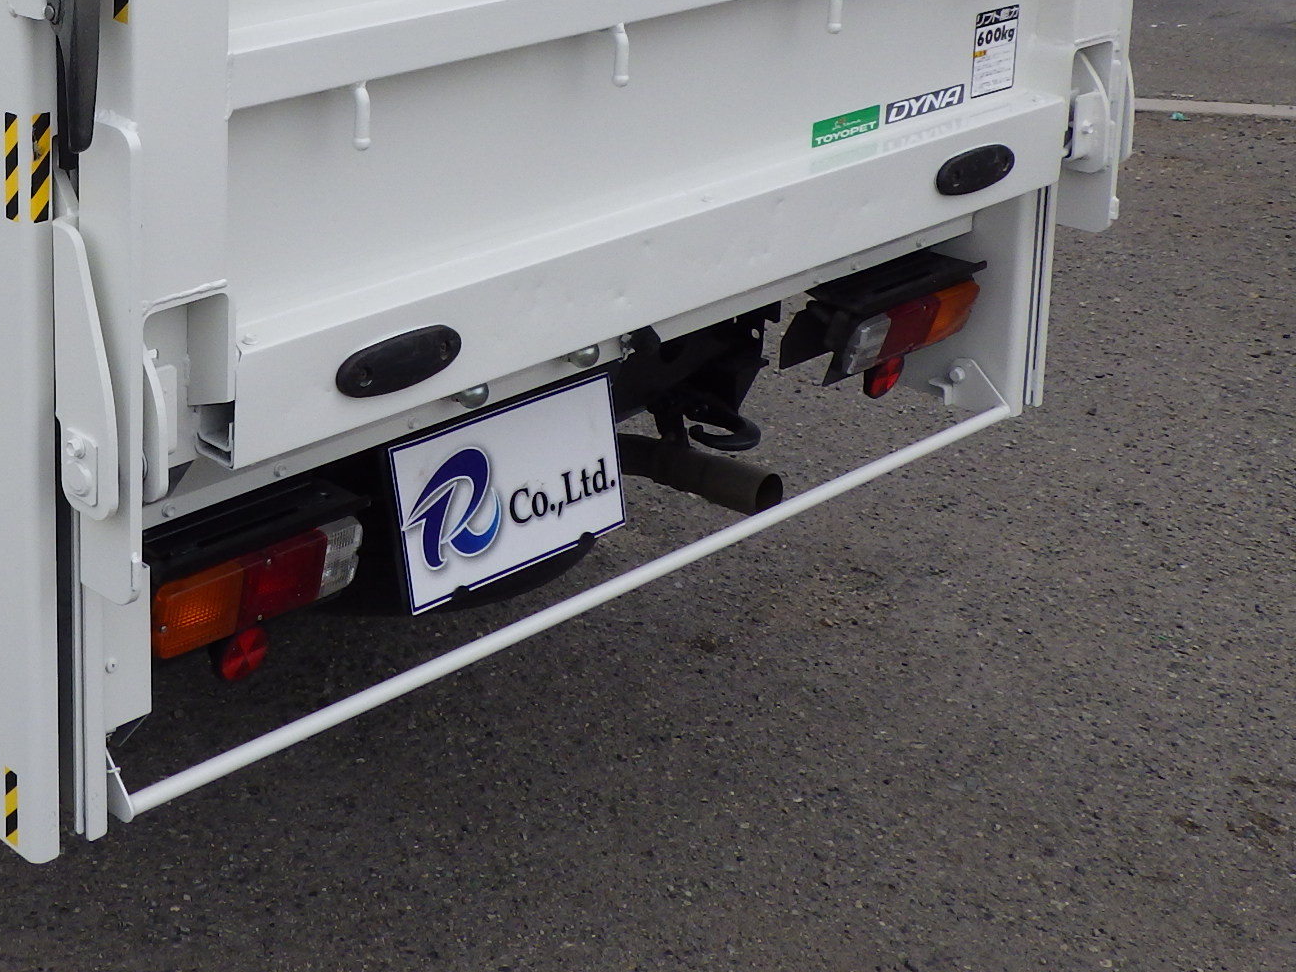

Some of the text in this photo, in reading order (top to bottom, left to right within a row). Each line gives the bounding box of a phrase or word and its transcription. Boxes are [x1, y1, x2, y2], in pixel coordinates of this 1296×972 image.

[977, 25, 1015, 46] 600kg
[888, 86, 962, 123] DYNA
[815, 121, 877, 145] TOYOPET
[509, 458, 616, 525] Co.,Ltd.
